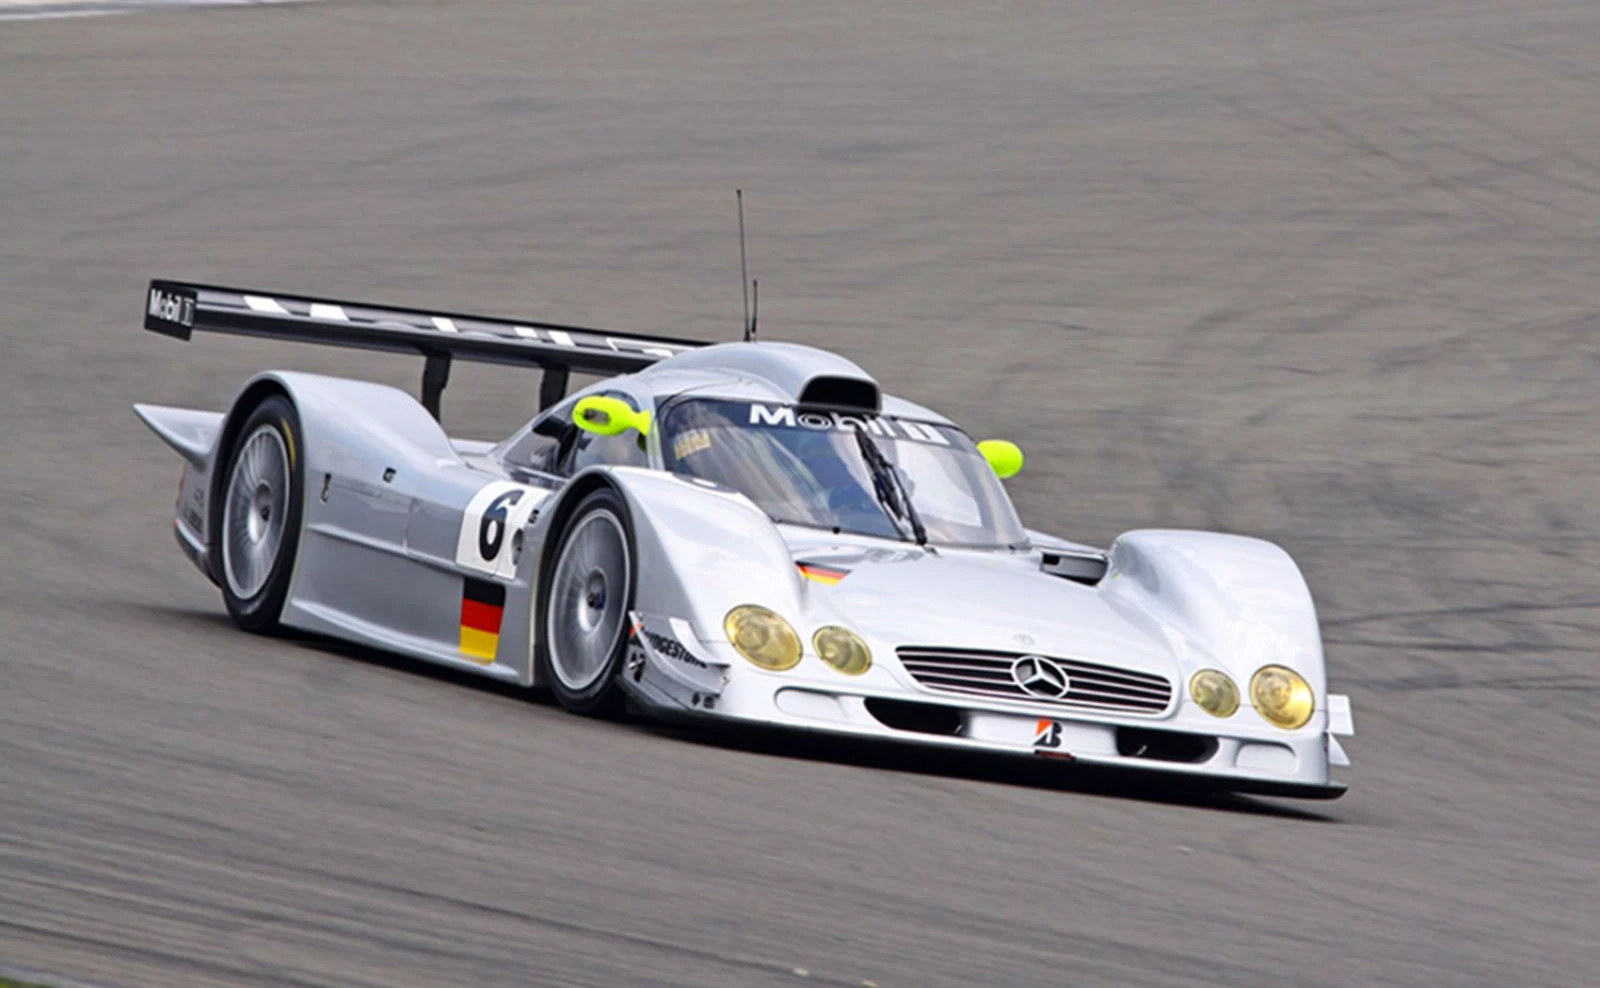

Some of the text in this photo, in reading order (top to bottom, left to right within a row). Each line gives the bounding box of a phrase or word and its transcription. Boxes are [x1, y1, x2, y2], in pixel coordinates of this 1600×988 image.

[149, 288, 182, 322] Mobil
[750, 403, 897, 437] Mobil
[479, 489, 525, 562] 6
